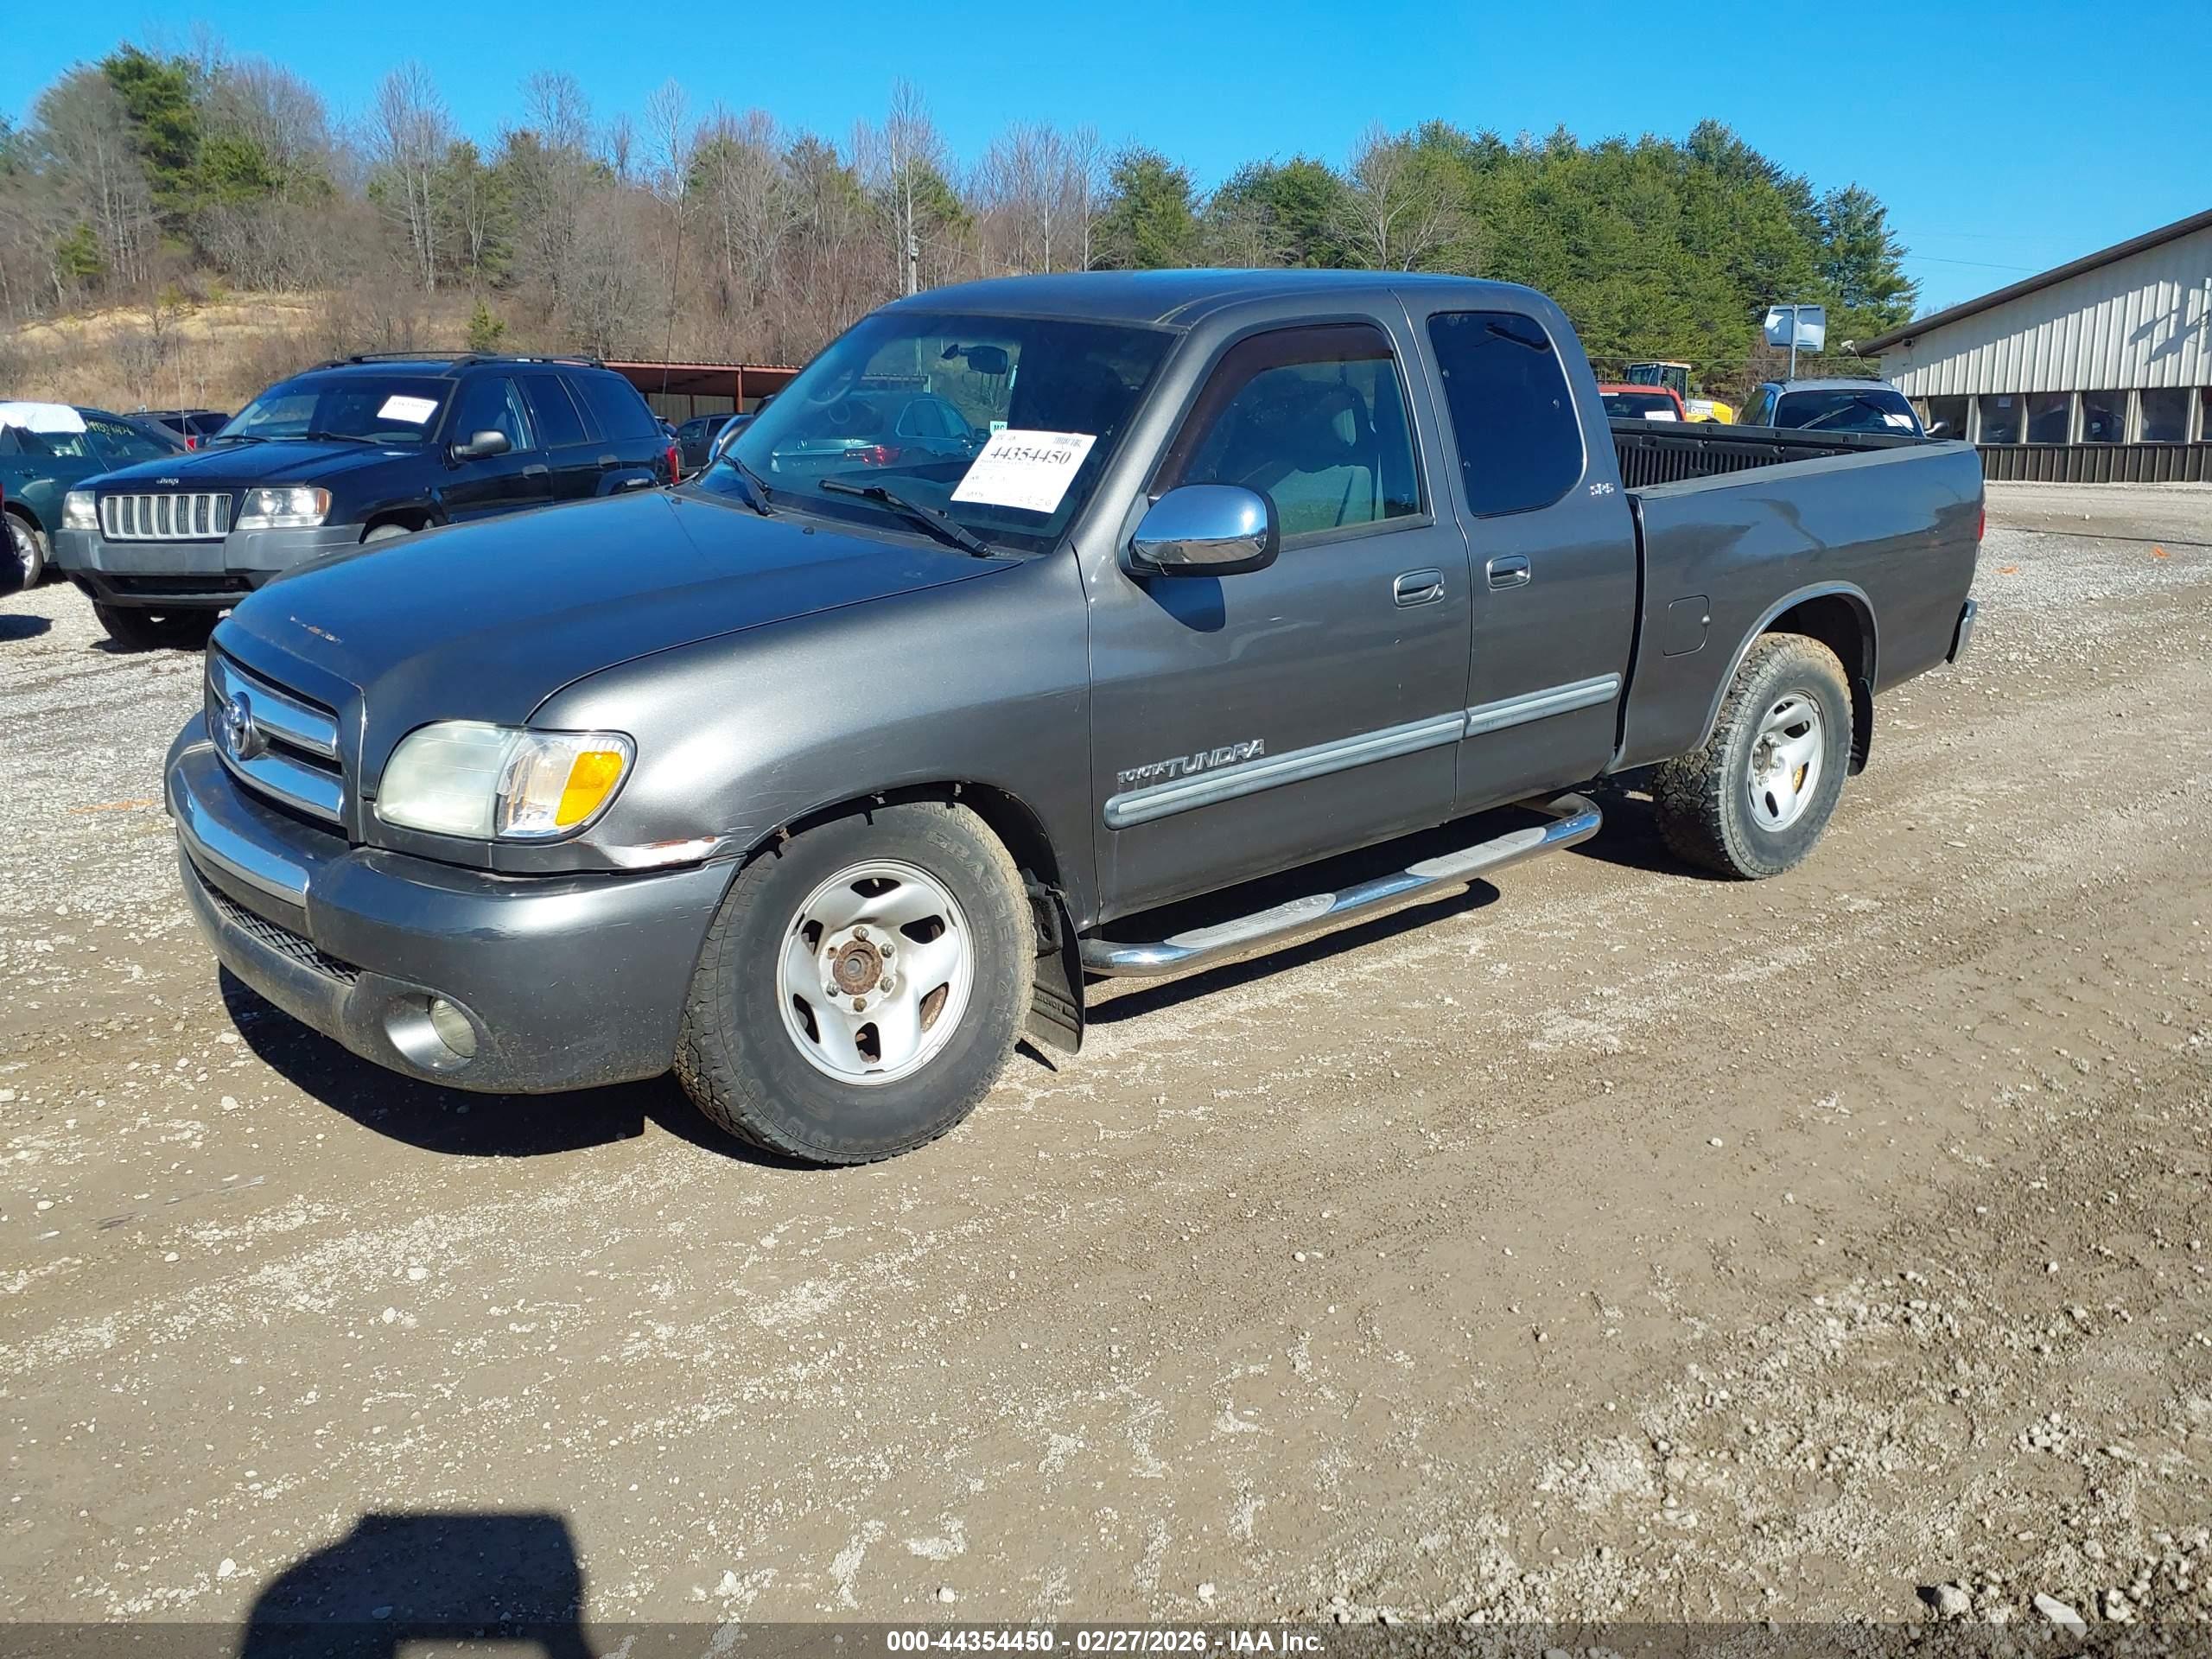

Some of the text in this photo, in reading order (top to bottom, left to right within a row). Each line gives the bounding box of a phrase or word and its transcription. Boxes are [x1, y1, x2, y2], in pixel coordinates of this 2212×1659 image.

[990, 445, 1072, 465] 44354450
[1116, 739, 1265, 784] TOYOTA TUNDRA
